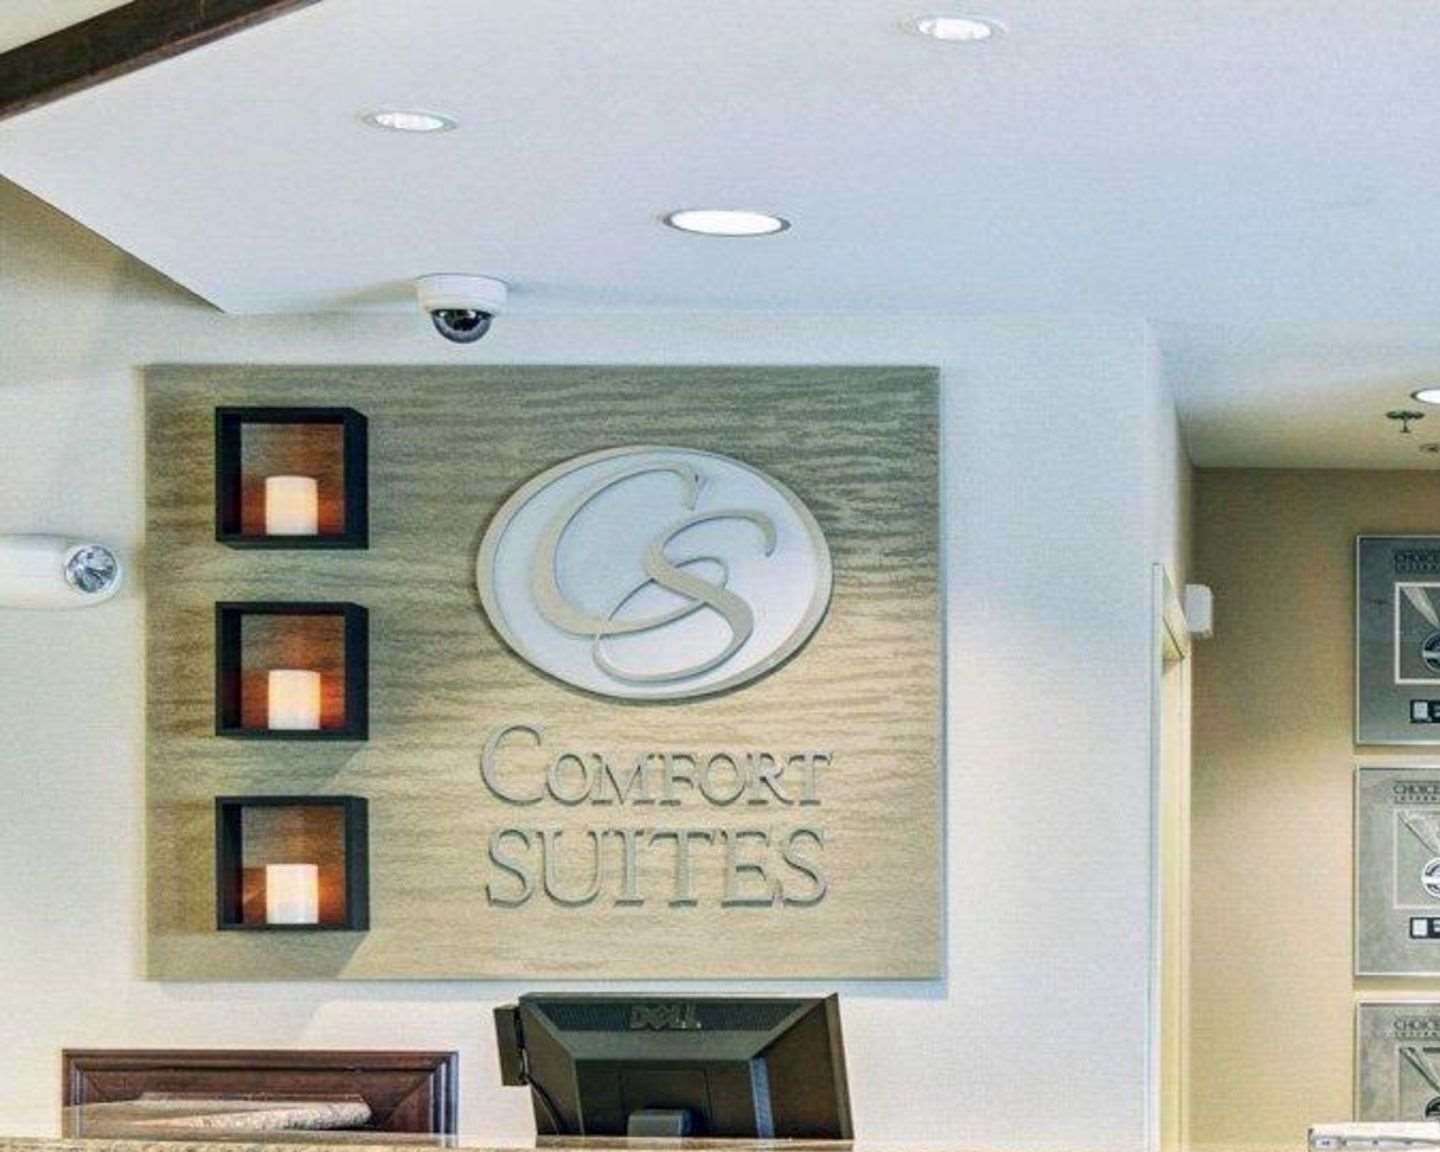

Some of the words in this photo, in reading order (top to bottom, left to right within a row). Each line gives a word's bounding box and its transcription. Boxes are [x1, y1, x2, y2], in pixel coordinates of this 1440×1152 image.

[480, 724, 833, 807] COMFORT
[1393, 785, 1440, 794] CHOICE
[485, 827, 828, 908] SUITES
[1393, 1020, 1440, 1031] CHOICE
